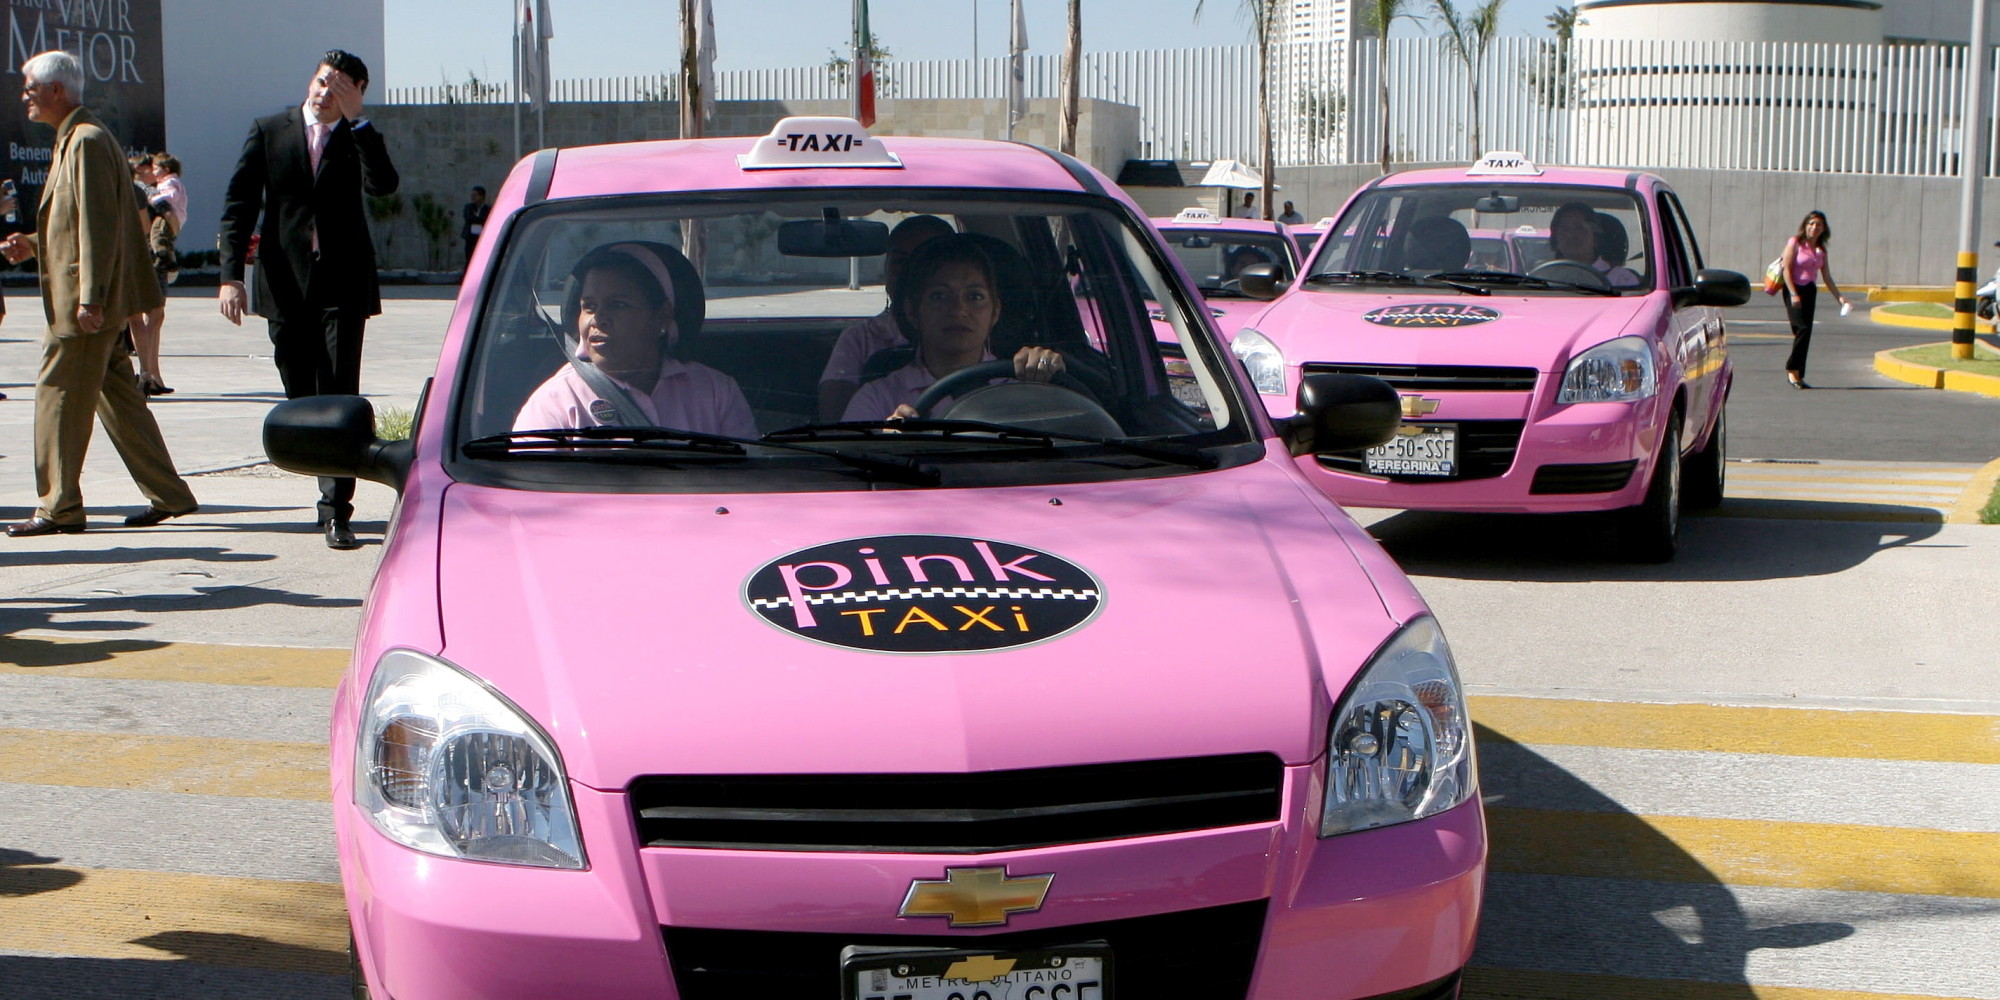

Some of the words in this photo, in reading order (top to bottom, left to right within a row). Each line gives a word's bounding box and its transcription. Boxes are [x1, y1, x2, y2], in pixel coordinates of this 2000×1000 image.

[59, 0, 135, 33] VIVIR
[1372, 304, 1487, 323] pink
[1368, 459, 1440, 472] PEREGRINA
[778, 541, 1056, 629] pink
